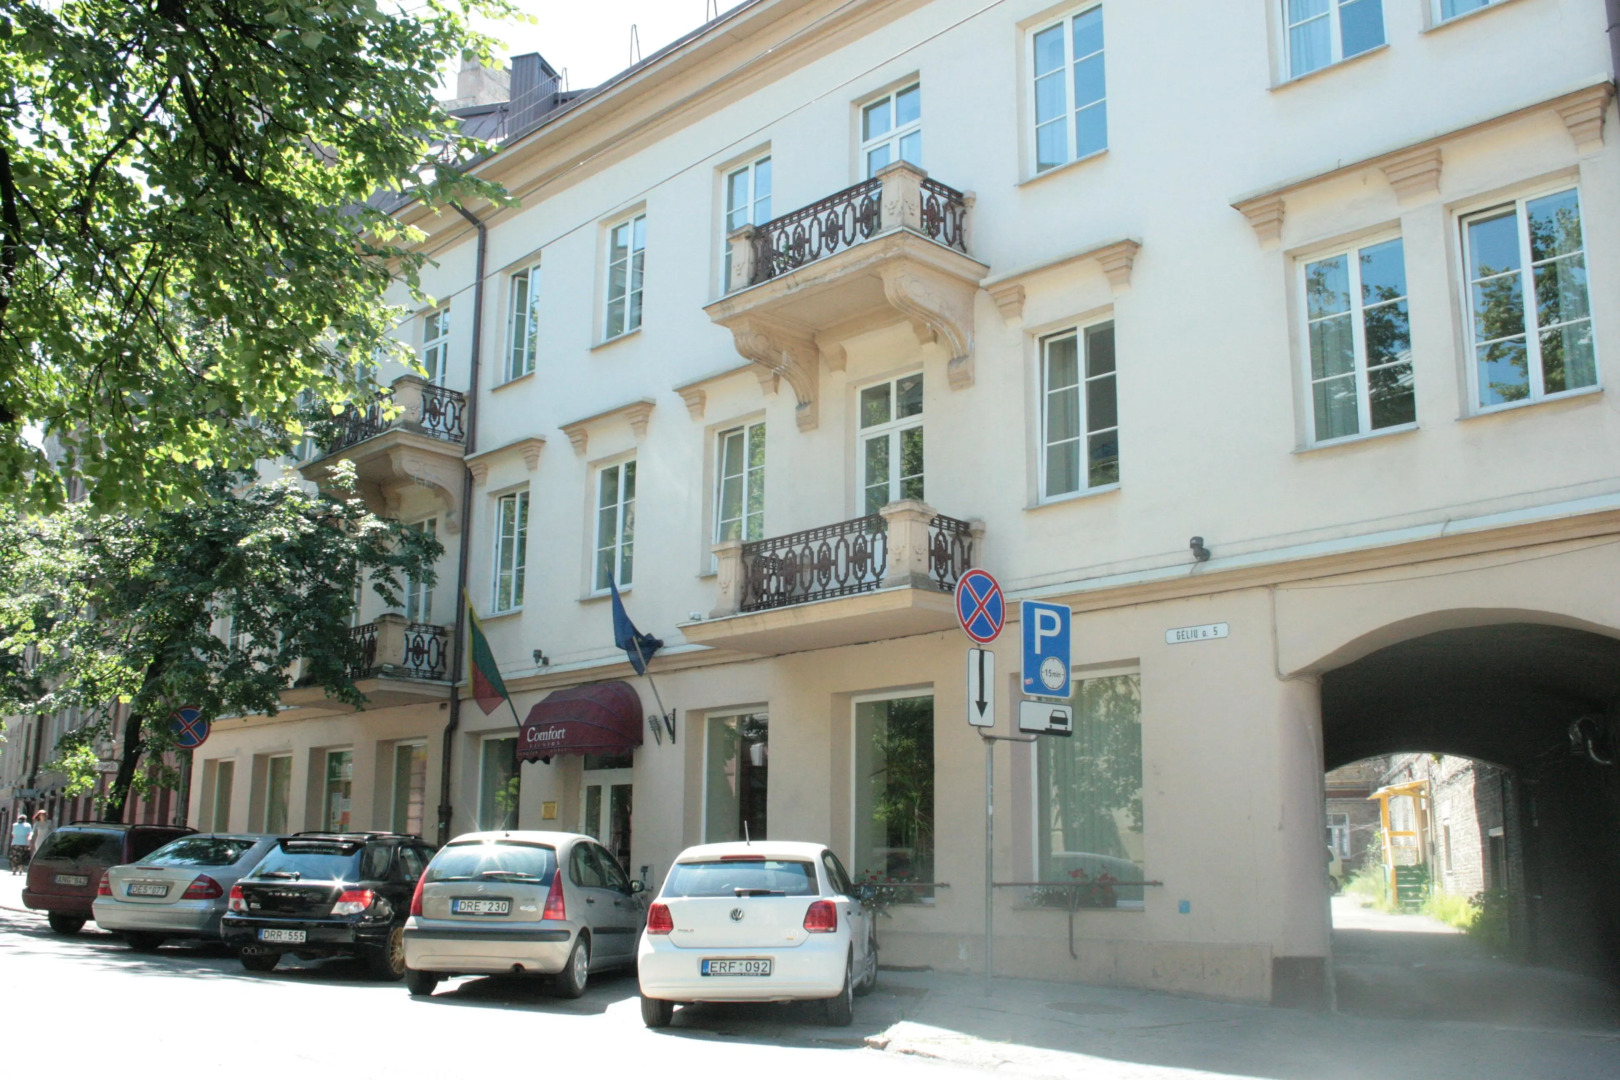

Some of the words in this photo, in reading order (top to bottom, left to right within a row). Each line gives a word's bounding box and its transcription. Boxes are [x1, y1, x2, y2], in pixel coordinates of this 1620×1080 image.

[1034, 607, 1062, 655] P
[1213, 626, 1218, 636] 5
[527, 726, 566, 742] Comfort
[132, 883, 148, 893] DES
[151, 885, 165, 895] 077
[459, 901, 481, 911] DRE
[487, 901, 507, 912] 230
[263, 930, 283, 940] DRR
[288, 931, 305, 941] 555
[710, 961, 737, 973] ERF
[744, 961, 769, 973] 092
